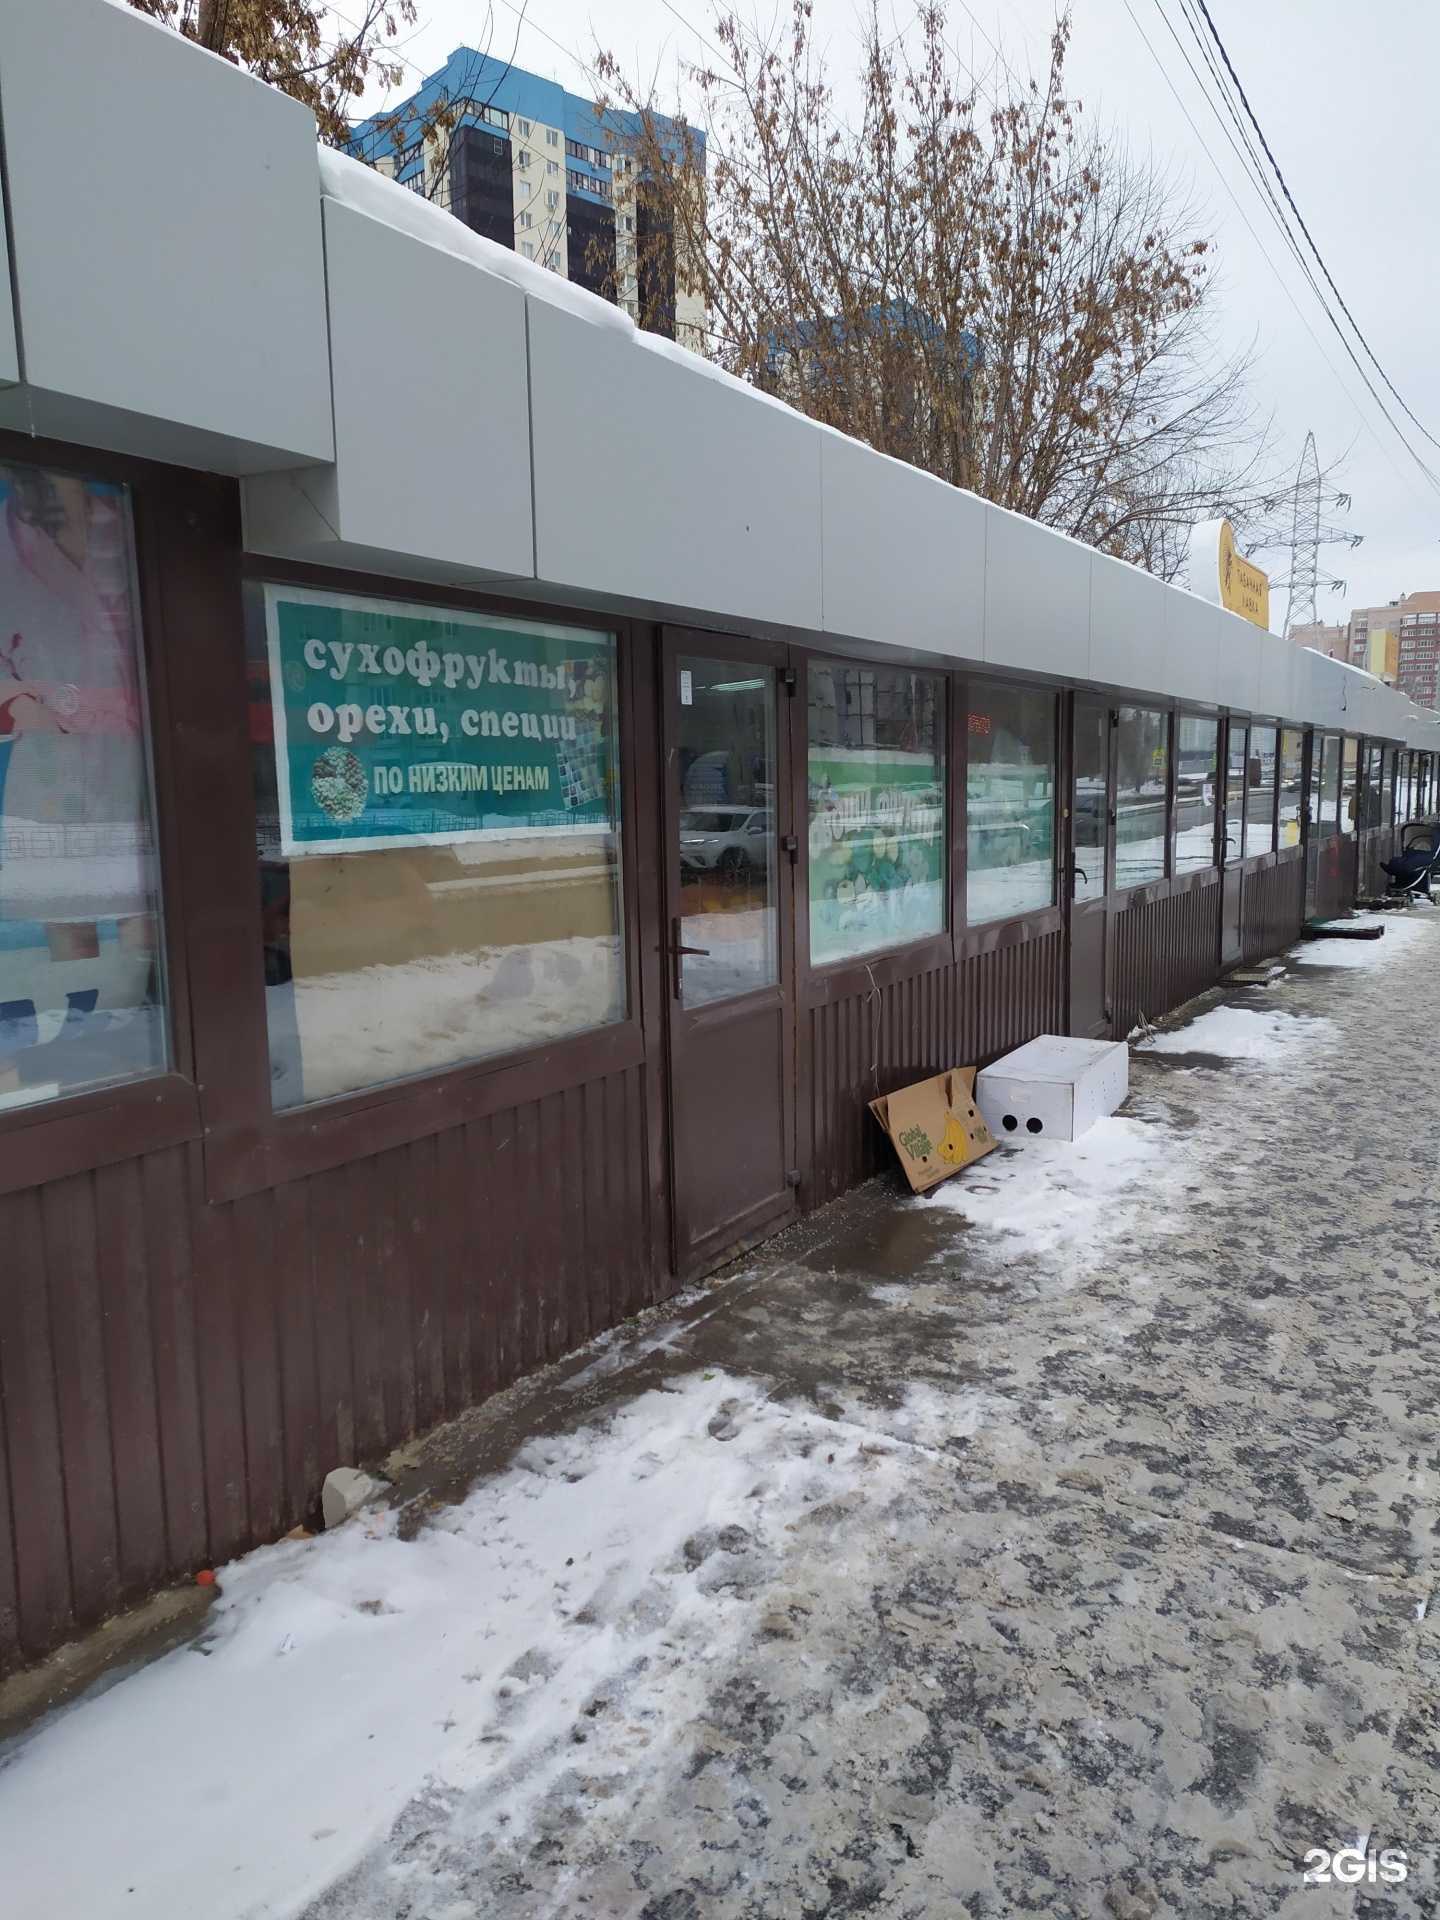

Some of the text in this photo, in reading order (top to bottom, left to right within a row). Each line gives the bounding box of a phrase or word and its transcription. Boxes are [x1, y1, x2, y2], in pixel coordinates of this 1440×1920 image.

[304, 639, 576, 698] сухофрукты,
[307, 702, 577, 743] орехи, специи
[374, 766, 549, 795] ПО НИЗКИМ ЦЕНАМ
